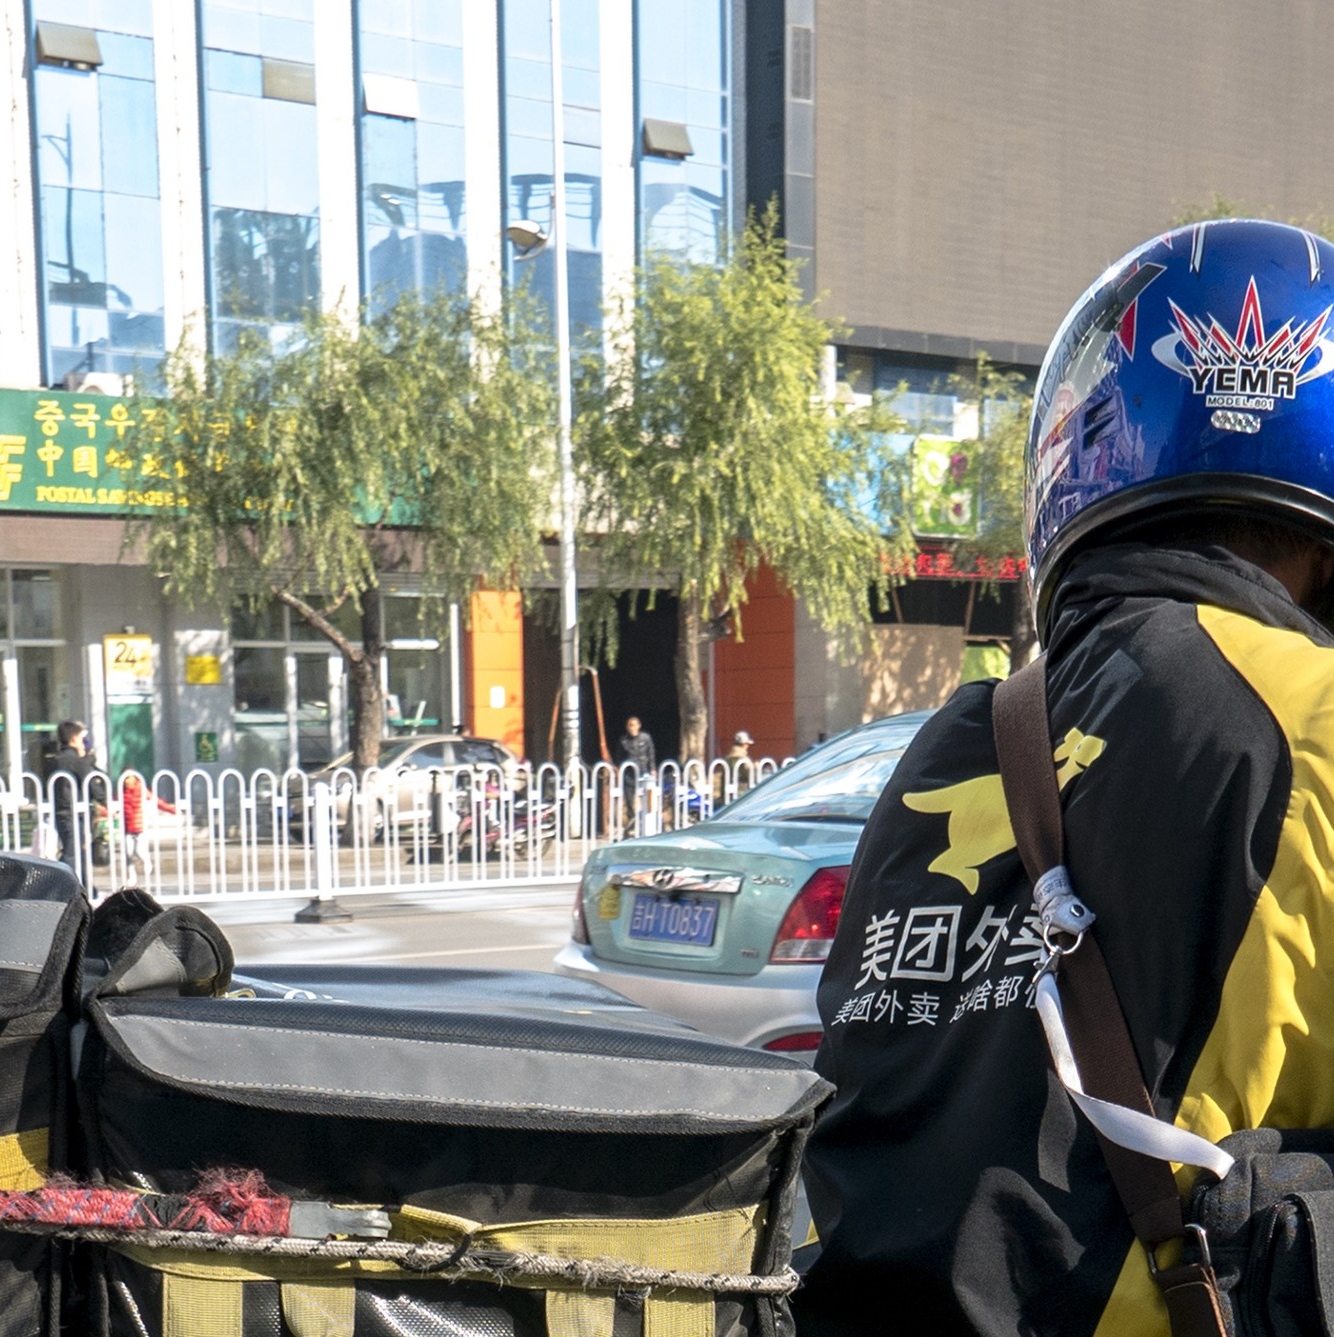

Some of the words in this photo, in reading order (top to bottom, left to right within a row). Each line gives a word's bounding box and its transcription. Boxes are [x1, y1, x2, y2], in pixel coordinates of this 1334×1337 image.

[1188, 364, 1298, 399] YEMA
[1206, 395, 1275, 410] MODEL:801
[36, 486, 96, 503] POSTAL
[831, 988, 940, 1027] 美团外卖
